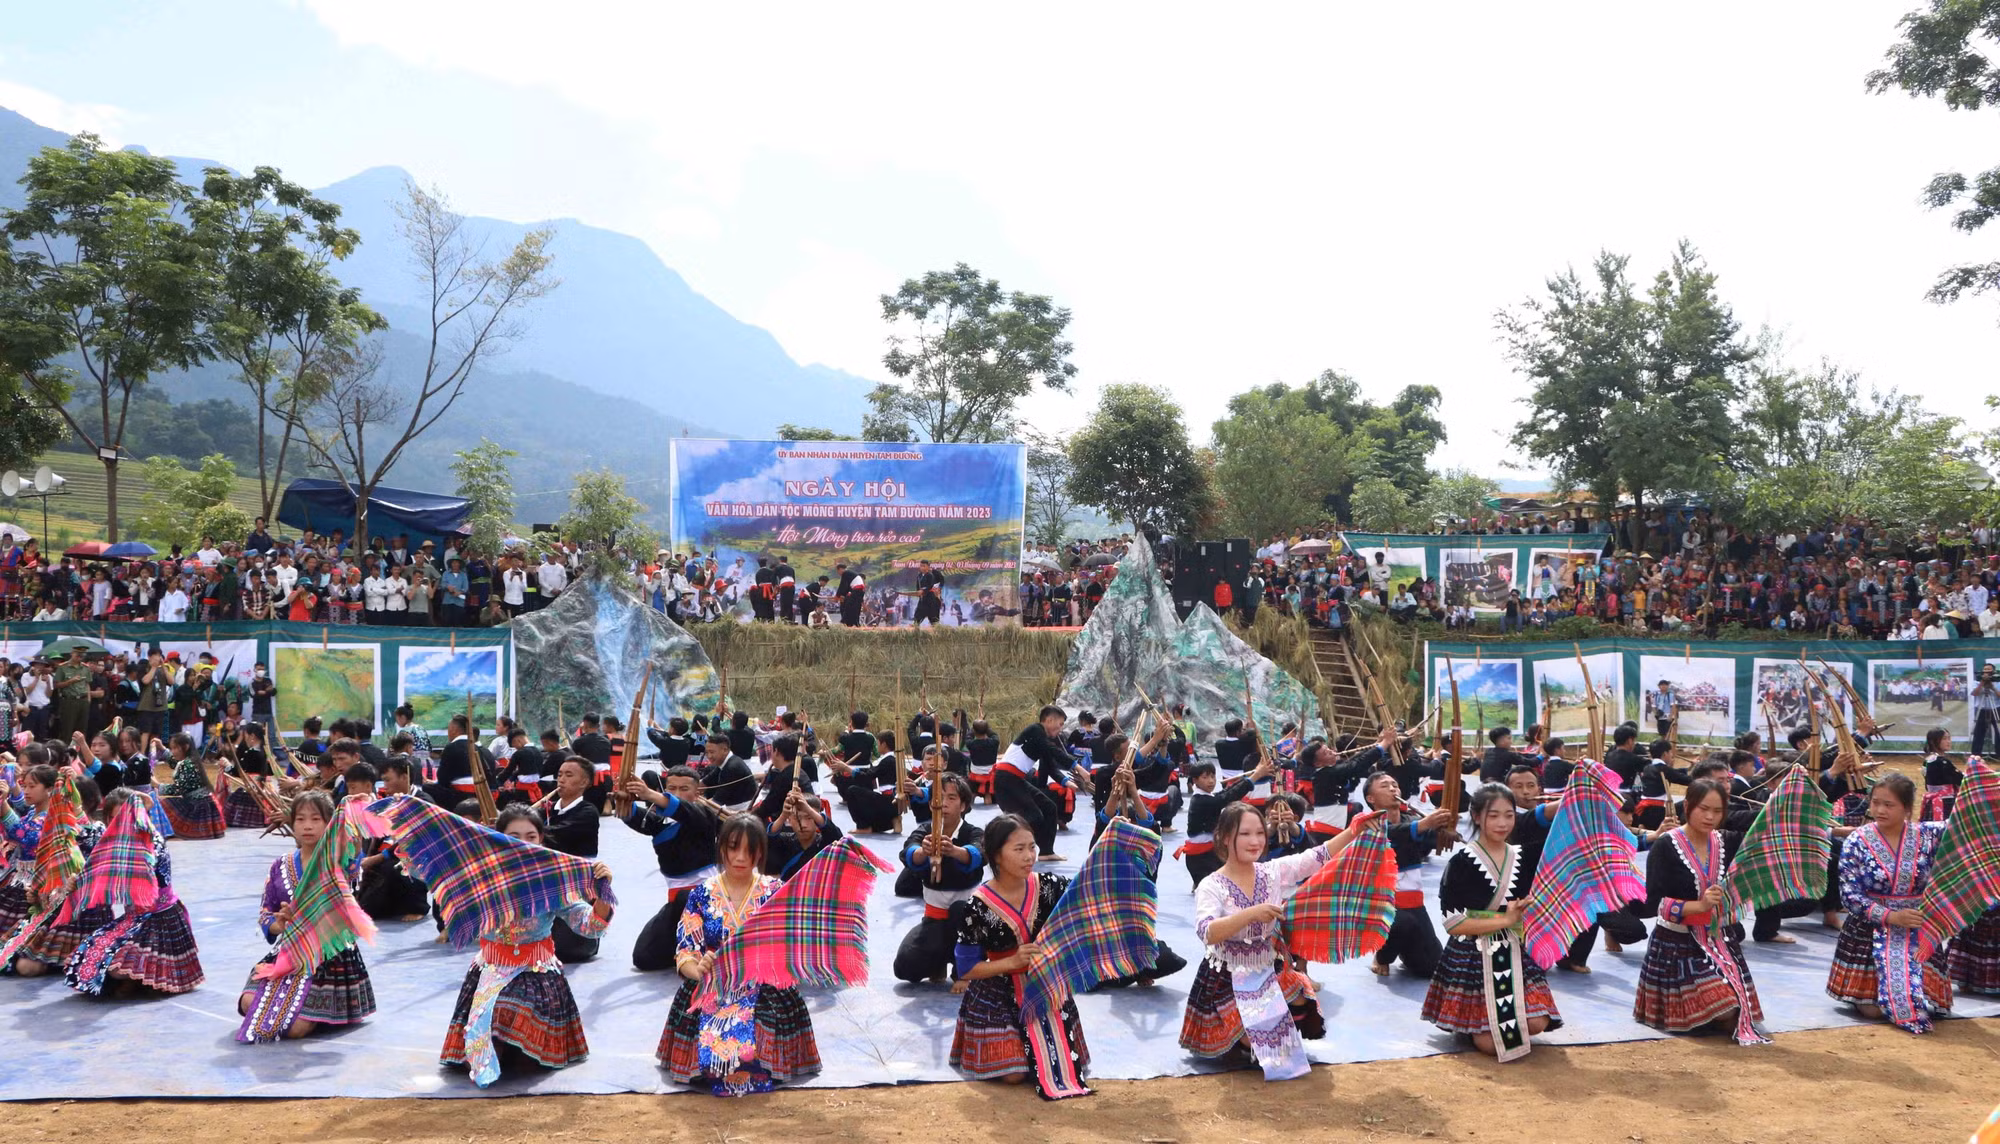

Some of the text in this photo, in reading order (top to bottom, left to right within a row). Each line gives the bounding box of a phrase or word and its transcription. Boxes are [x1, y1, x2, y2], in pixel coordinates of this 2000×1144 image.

[807, 450, 830, 459] NHÂN
[785, 476, 906, 501] NGÀY HỘI
[706, 502, 991, 519] VĂN HÓA DÂN TỘC MÔNG HUYỆN TAM ĐƯỜNG NĂM 2023
[802, 526, 849, 549] Mông
[851, 531, 875, 543] trên
